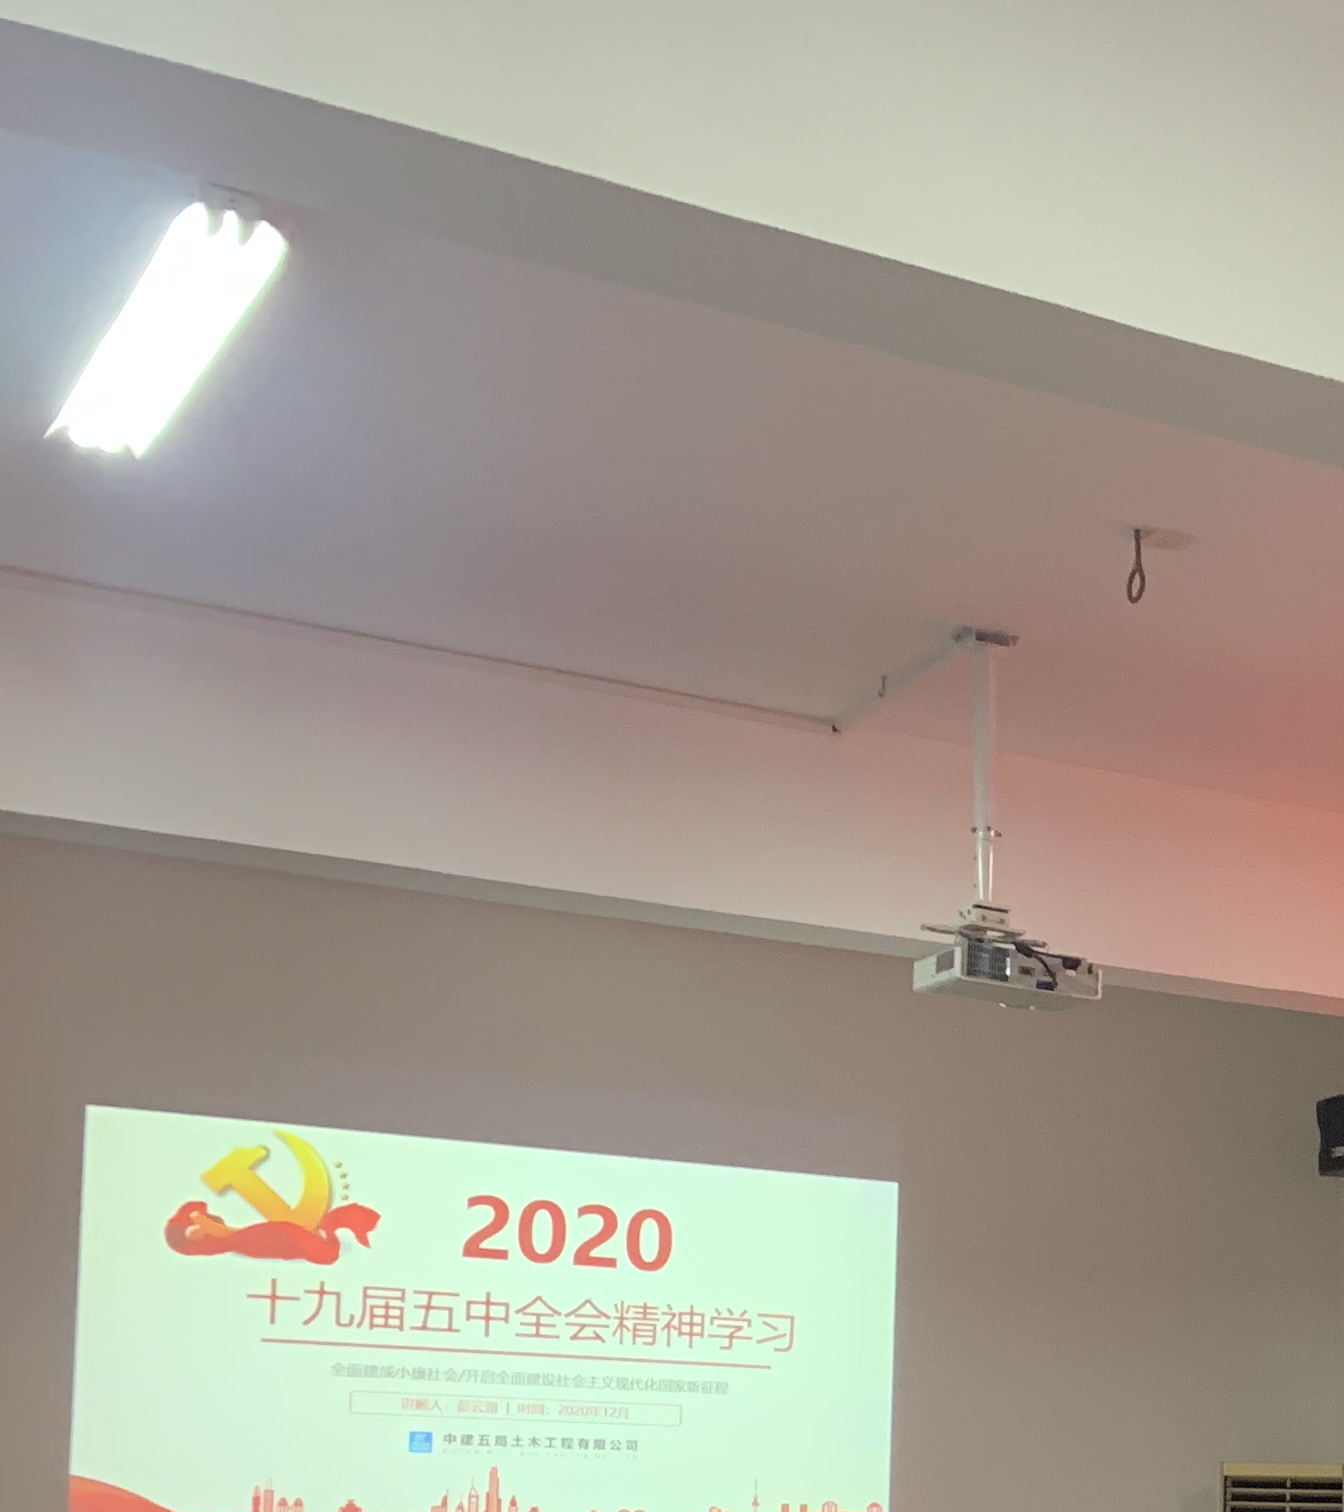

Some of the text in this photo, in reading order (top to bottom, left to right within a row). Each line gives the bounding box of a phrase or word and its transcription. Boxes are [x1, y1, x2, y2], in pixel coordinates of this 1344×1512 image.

[462, 1194, 673, 1272] 2020
[246, 1277, 796, 1354] 十九届五中全会精神学习
[442, 1432, 639, 1452] 中建五局土木工程有限公司
